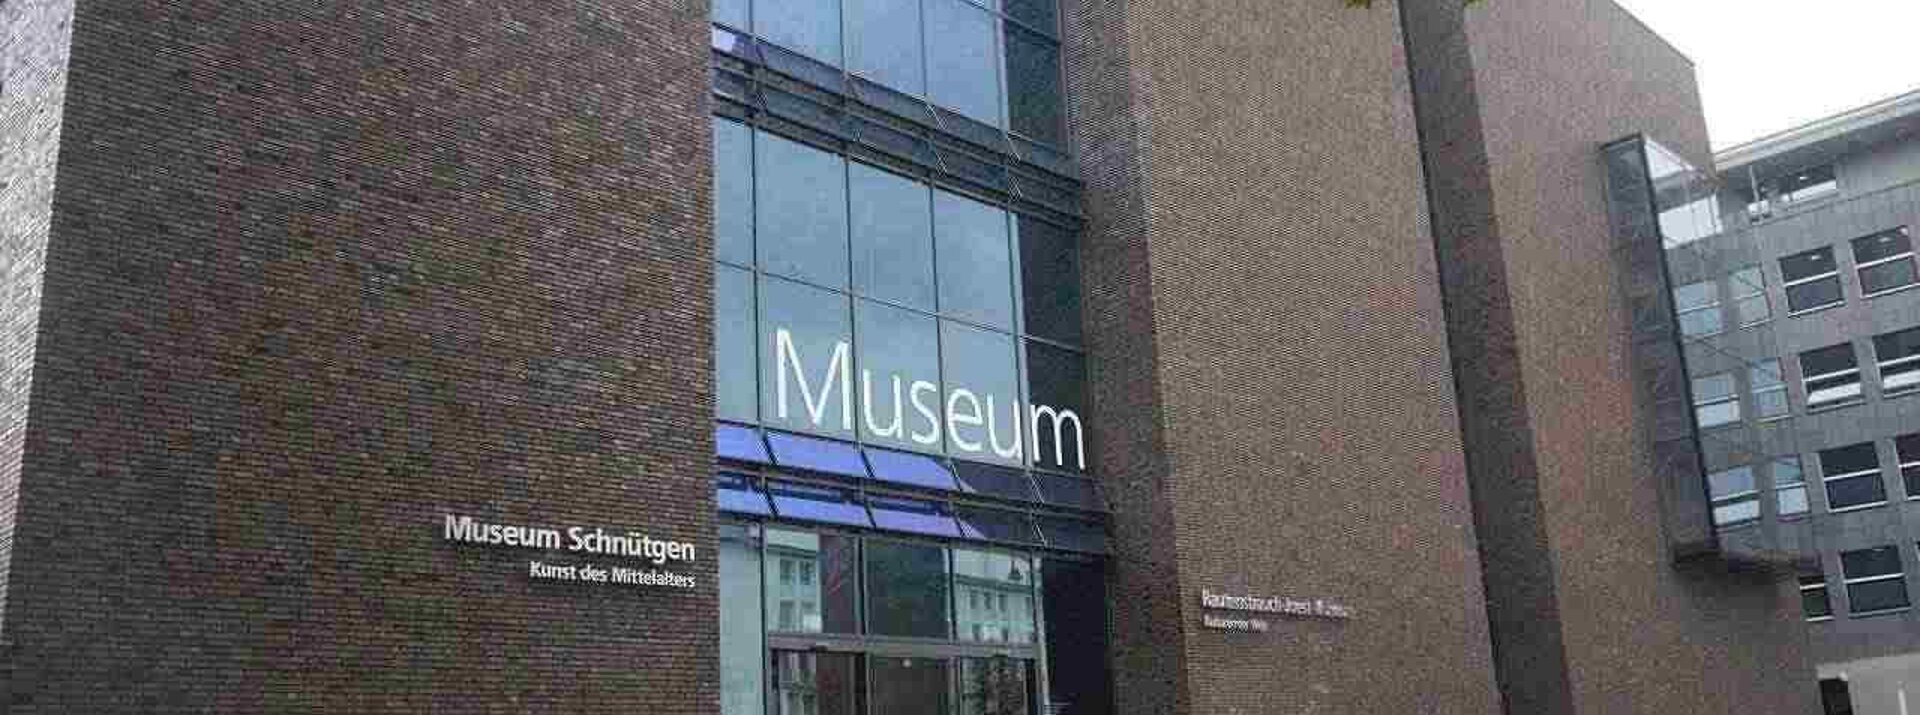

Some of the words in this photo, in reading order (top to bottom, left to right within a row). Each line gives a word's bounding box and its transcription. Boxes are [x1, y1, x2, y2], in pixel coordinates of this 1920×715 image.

[776, 327, 1086, 471] Museum
[444, 514, 561, 550] Museum
[568, 526, 696, 564] Schnütgen
[529, 560, 577, 581] Kunst
[579, 566, 608, 583] des
[612, 567, 696, 589] Mittelalters
